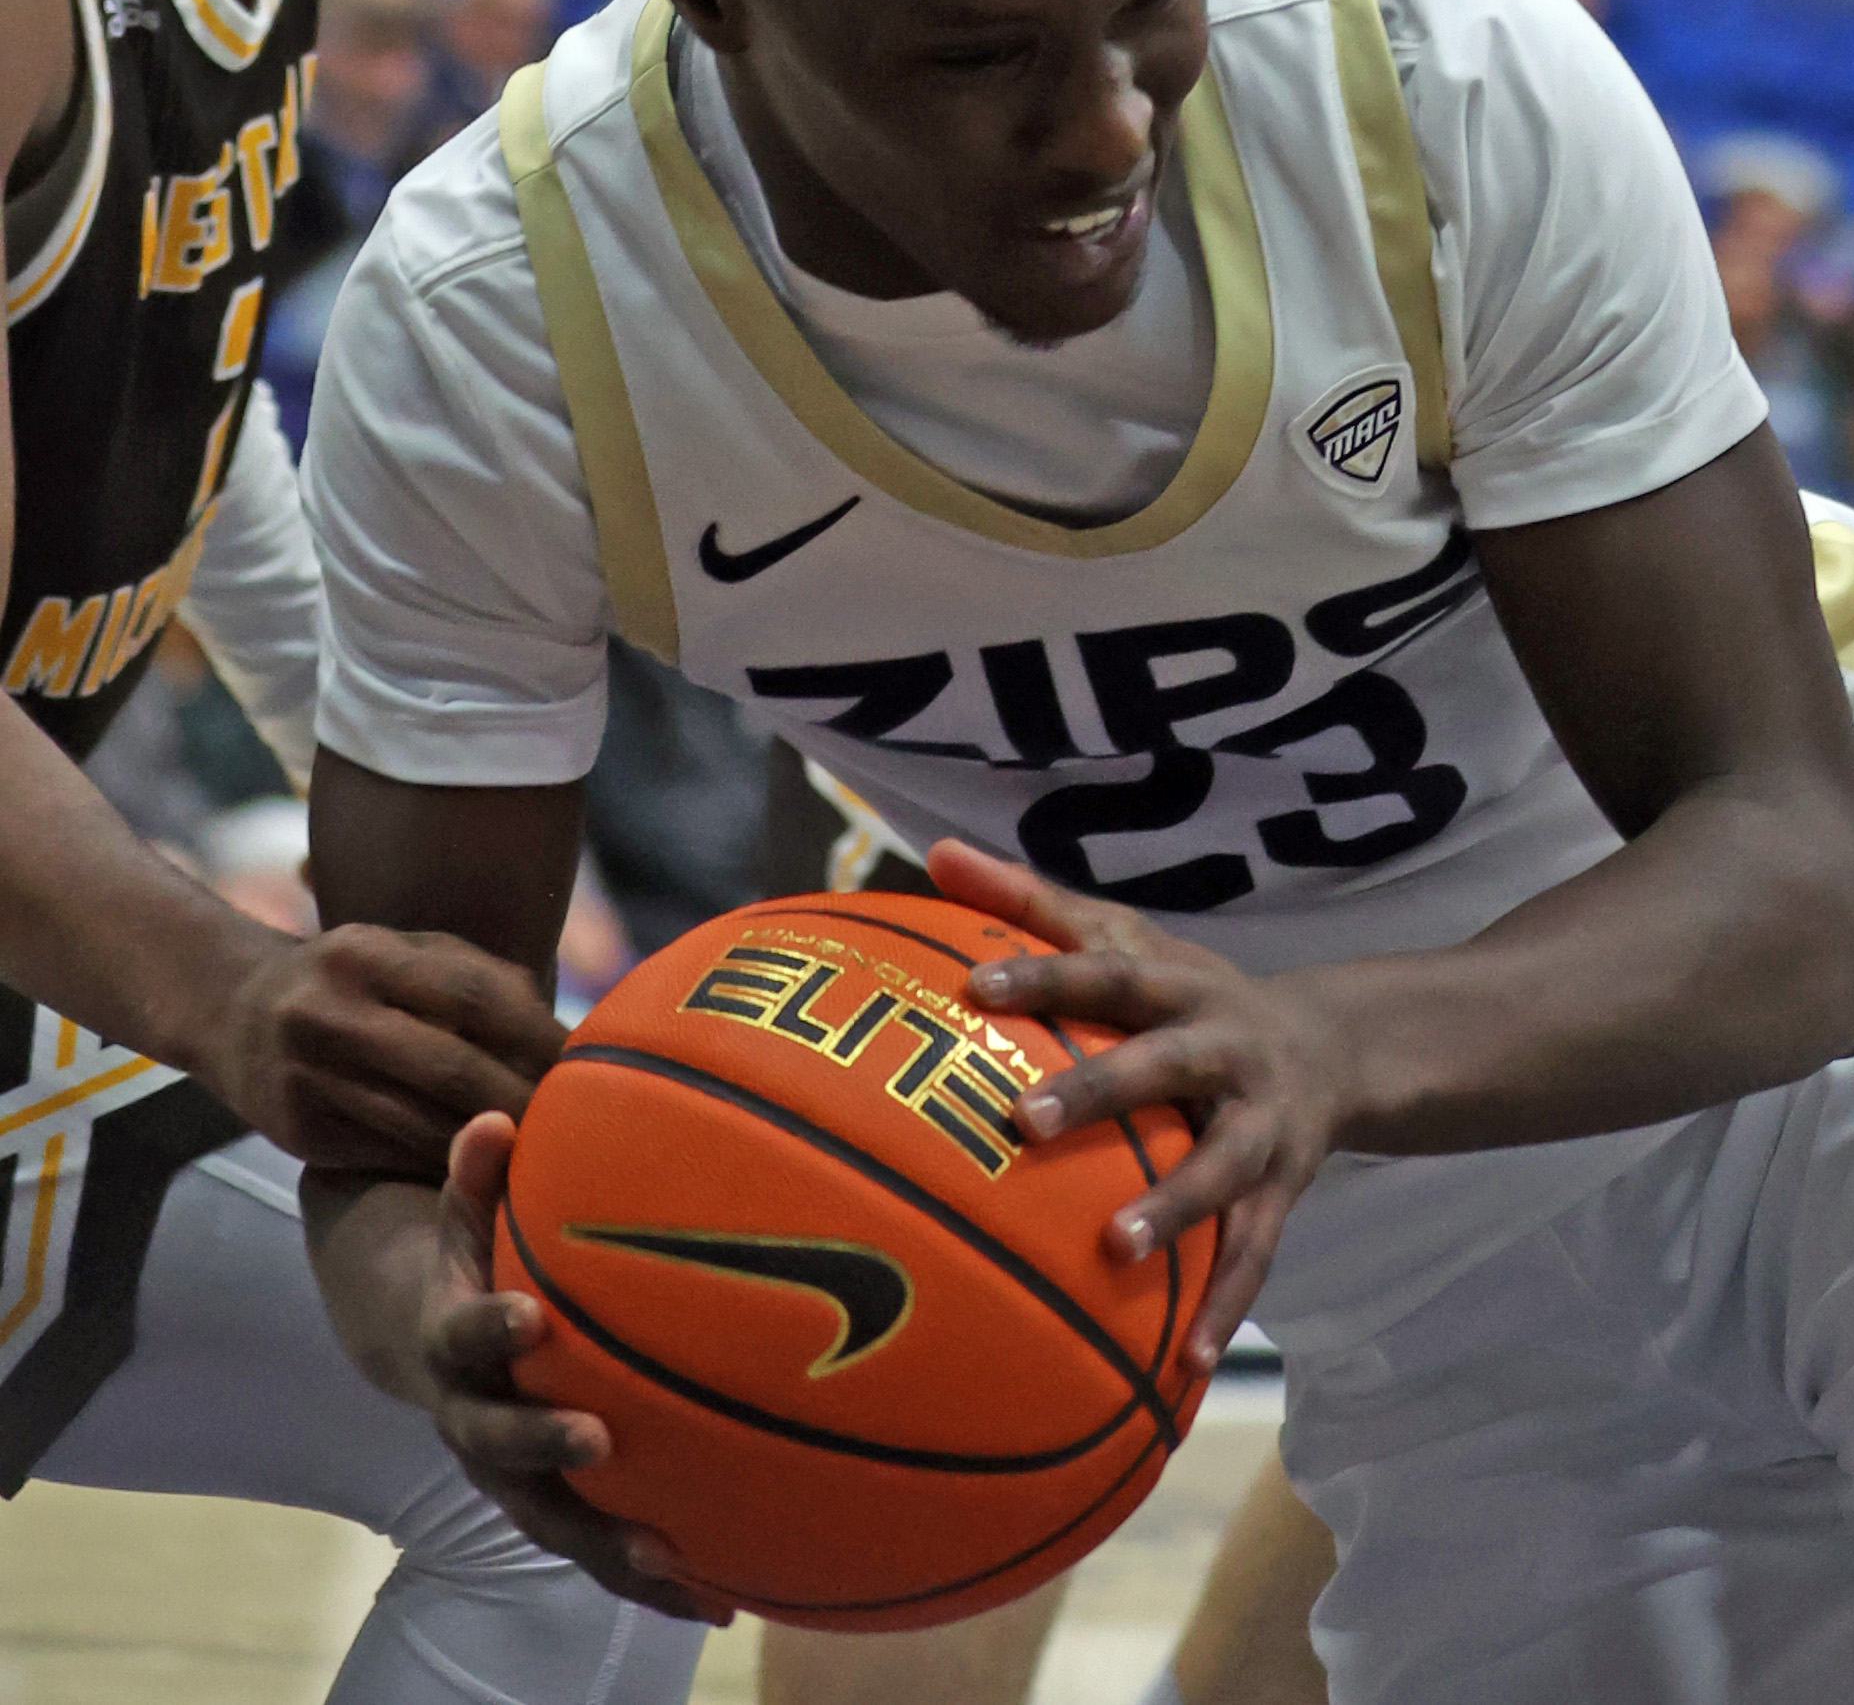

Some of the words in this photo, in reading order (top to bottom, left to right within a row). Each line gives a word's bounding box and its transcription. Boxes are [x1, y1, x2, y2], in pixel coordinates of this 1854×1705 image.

[1323, 398, 1401, 465] MAC
[745, 528, 1484, 772] ZIPS
[1018, 670, 1469, 913] 23
[677, 944, 1023, 1182] ELITE
